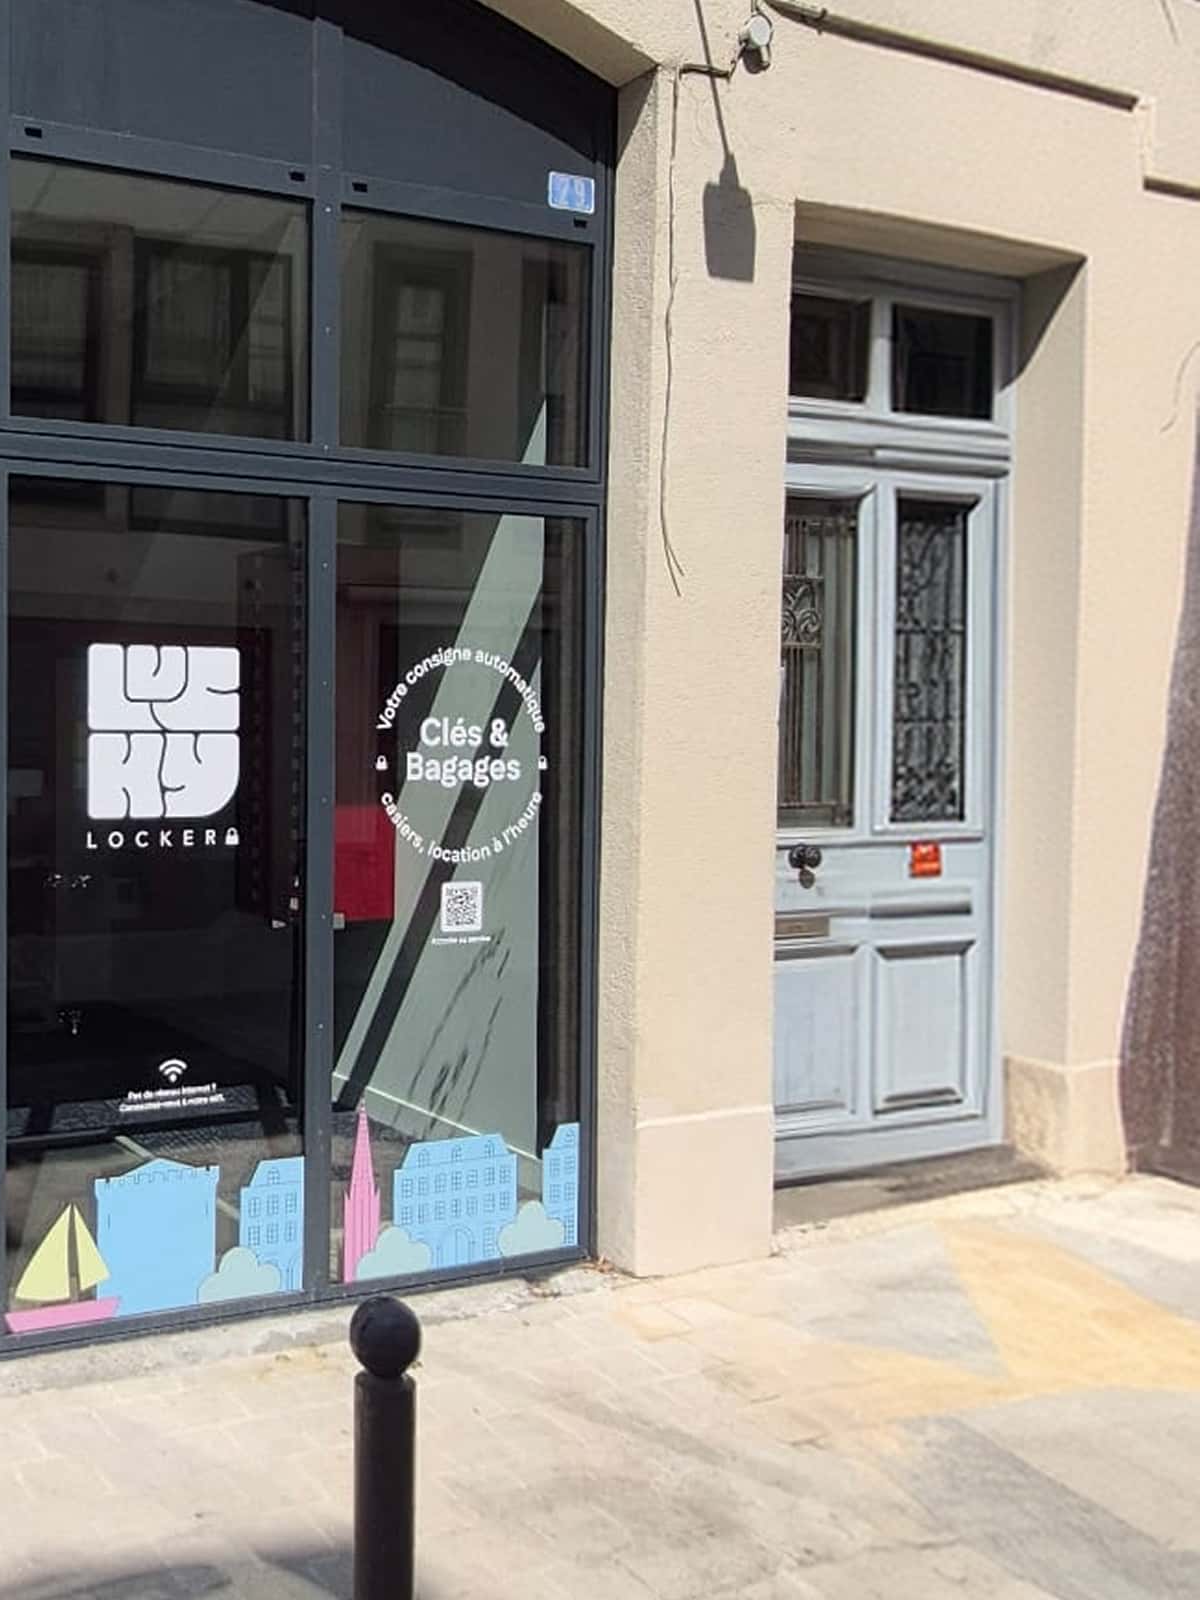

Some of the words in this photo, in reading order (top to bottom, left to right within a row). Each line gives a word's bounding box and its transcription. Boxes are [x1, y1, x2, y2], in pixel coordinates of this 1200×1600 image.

[376, 683, 408, 729] Votre
[406, 647, 471, 684] consigne
[475, 650, 545, 733] automatique
[420, 717, 482, 747] Clés
[490, 718, 509, 747] &
[406, 752, 521, 787] Bagages
[86, 829, 216, 849] LOCKER
[381, 793, 425, 853] casiers,
[427, 840, 492, 862] location
[492, 836, 503, 853] à
[502, 792, 543, 845] l'heure
